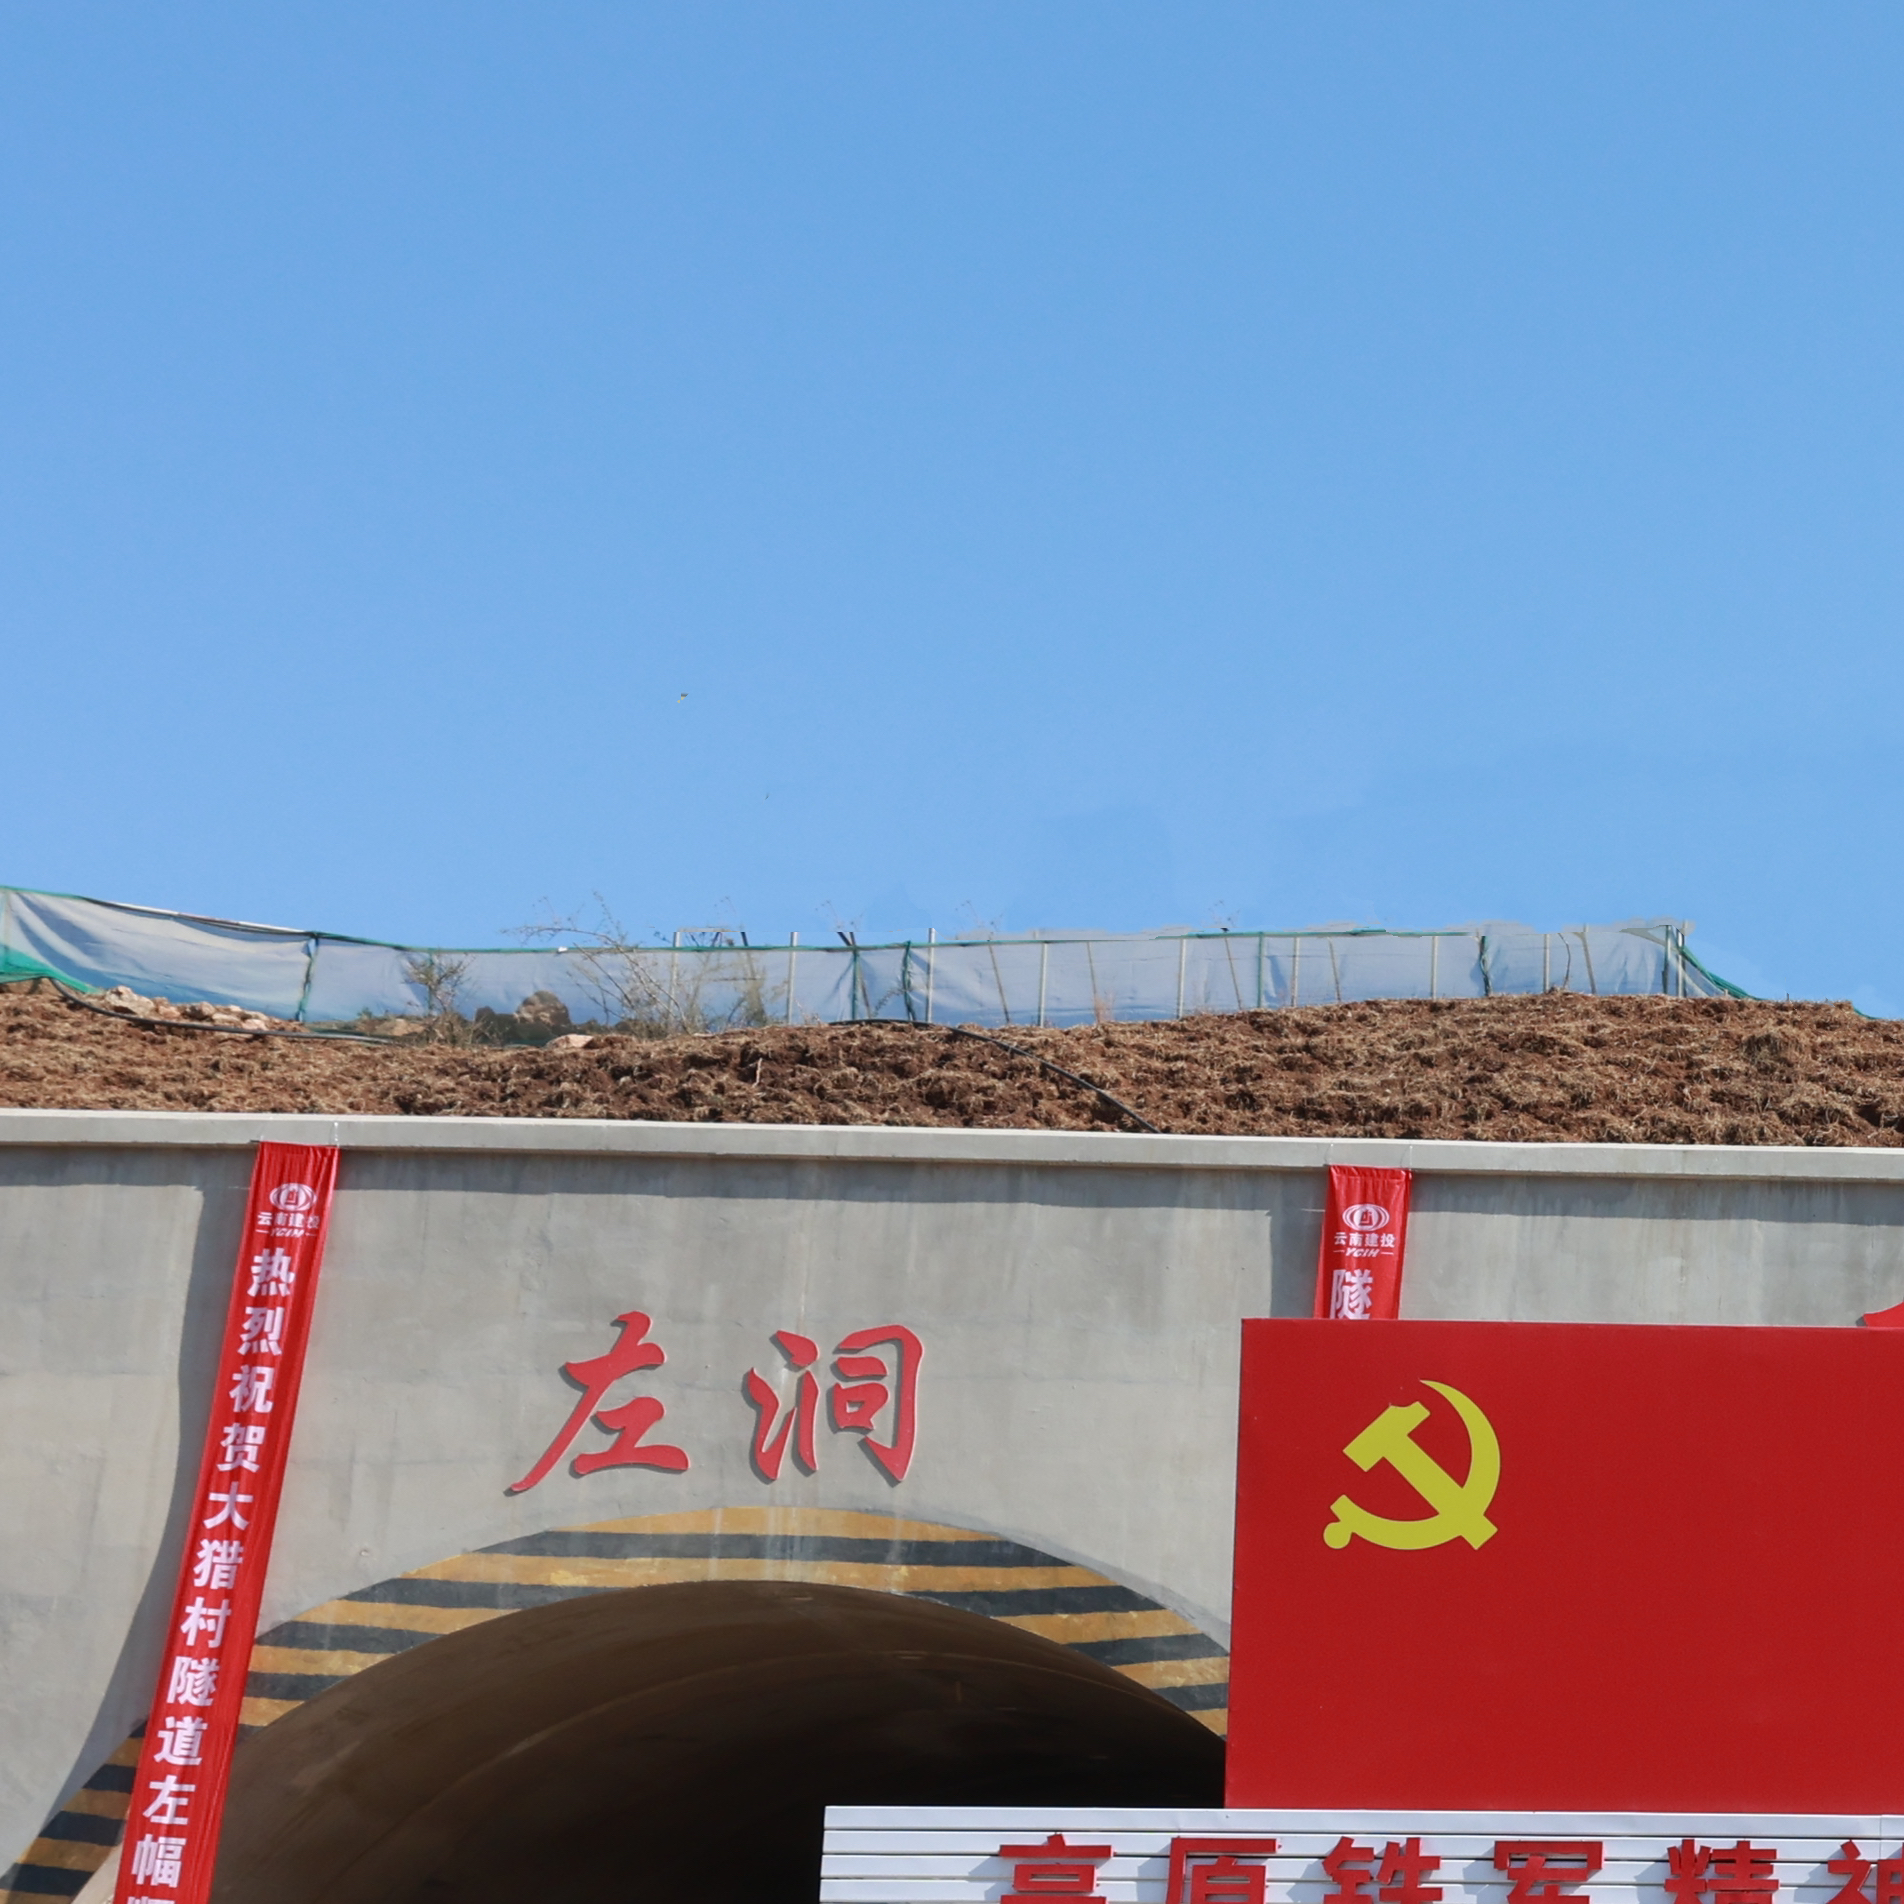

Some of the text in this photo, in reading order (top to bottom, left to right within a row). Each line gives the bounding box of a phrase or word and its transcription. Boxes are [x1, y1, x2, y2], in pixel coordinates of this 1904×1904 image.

[1334, 1232, 1396, 1248] 云南建投
[1345, 1247, 1381, 1258] YCIH
[508, 1310, 925, 1496] 左洞
